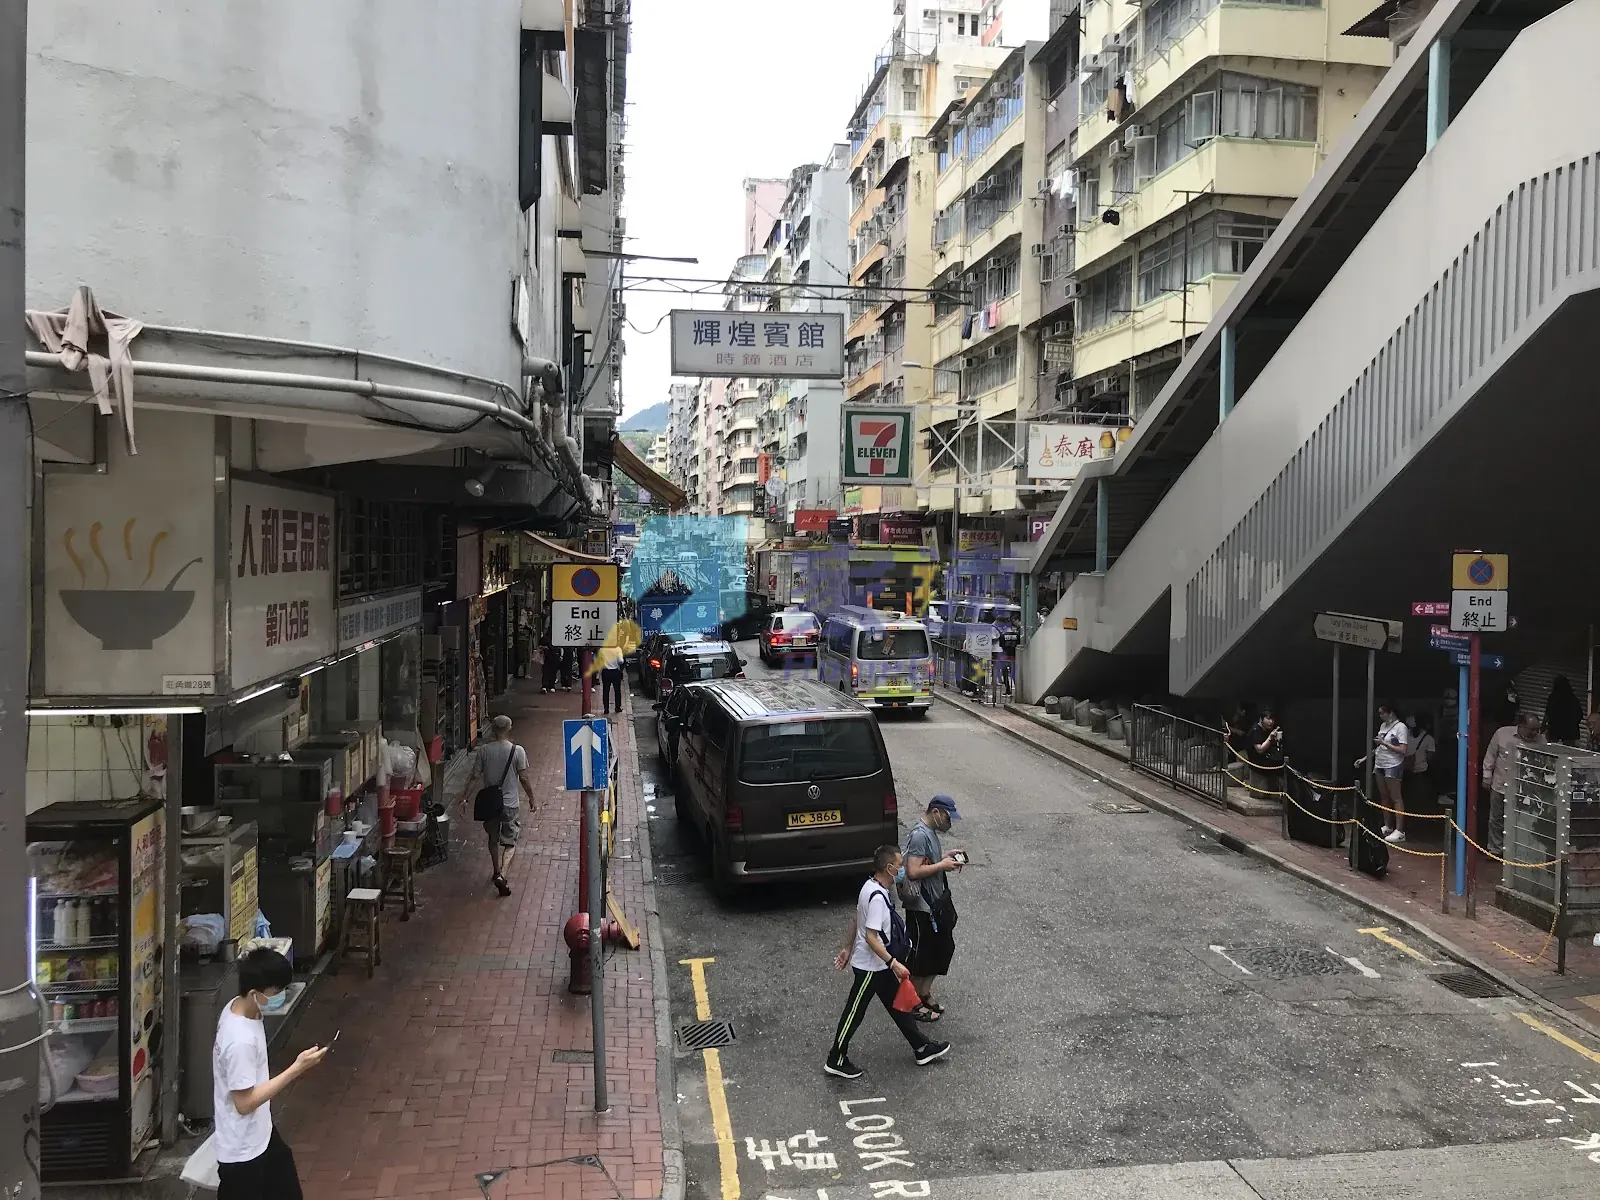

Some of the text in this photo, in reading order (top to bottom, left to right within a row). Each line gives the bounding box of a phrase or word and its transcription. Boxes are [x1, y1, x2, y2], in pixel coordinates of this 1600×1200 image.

[693, 319, 825, 349] 輝煌賓館
[716, 352, 814, 368] 時鐘酒店
[1054, 434, 1096, 459] 泰廚
[238, 504, 331, 579] 人和豆品廠
[1469, 595, 1492, 606] End
[571, 606, 600, 620] End
[1461, 611, 1496, 628] 終止
[266, 600, 311, 647] 第八分店
[564, 624, 605, 642] 終止
[790, 810, 838, 825] MC 3866
[839, 1097, 916, 1172] LOOK
